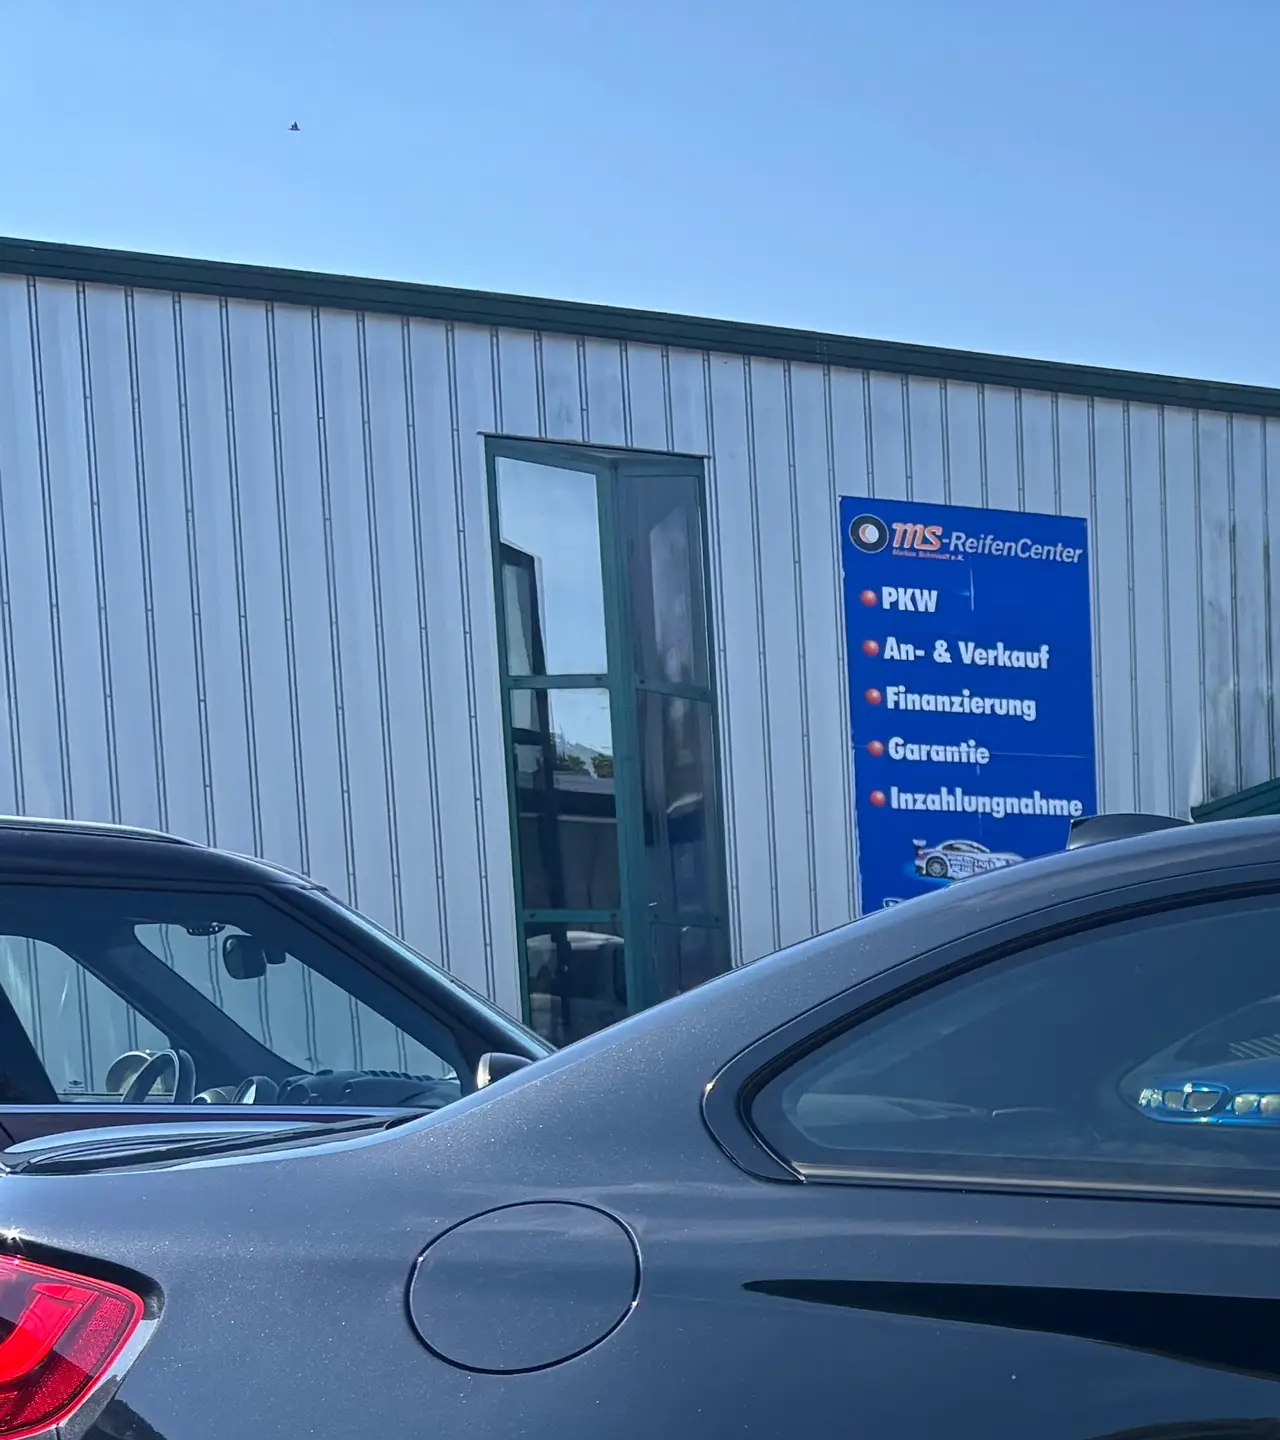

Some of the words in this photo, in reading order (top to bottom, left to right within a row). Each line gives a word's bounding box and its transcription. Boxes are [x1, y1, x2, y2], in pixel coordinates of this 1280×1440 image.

[881, 586, 938, 613] PKW
[884, 636, 925, 661] An-
[933, 639, 952, 663] &
[958, 641, 1049, 669] Verkauf
[886, 685, 1036, 721] Finanzierung
[888, 736, 990, 764] Garantie
[890, 786, 1084, 819] Inzahlungnahme
